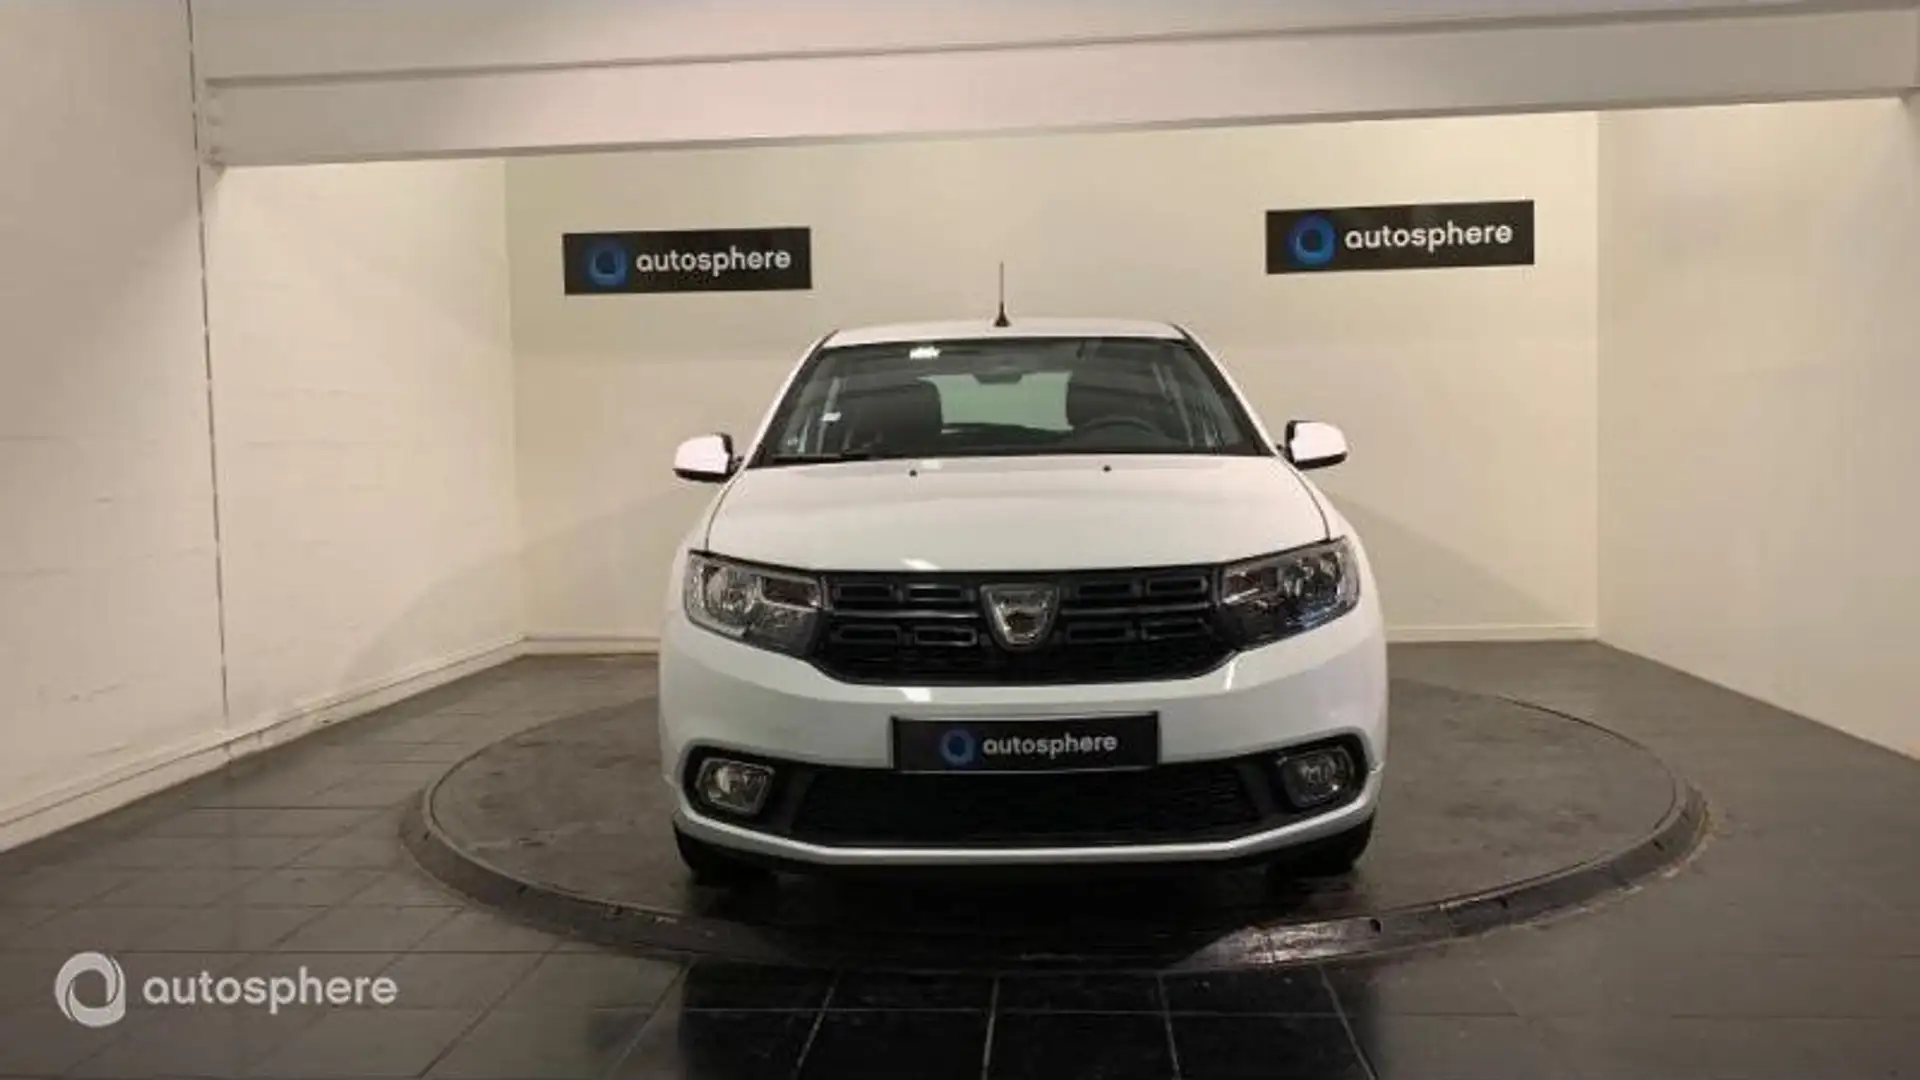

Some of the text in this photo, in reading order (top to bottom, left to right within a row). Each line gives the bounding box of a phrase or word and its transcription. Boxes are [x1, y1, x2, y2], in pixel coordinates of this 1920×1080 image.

[1344, 219, 1513, 253] autosphere
[635, 244, 792, 277] autosphere
[983, 732, 1118, 759] autosphere
